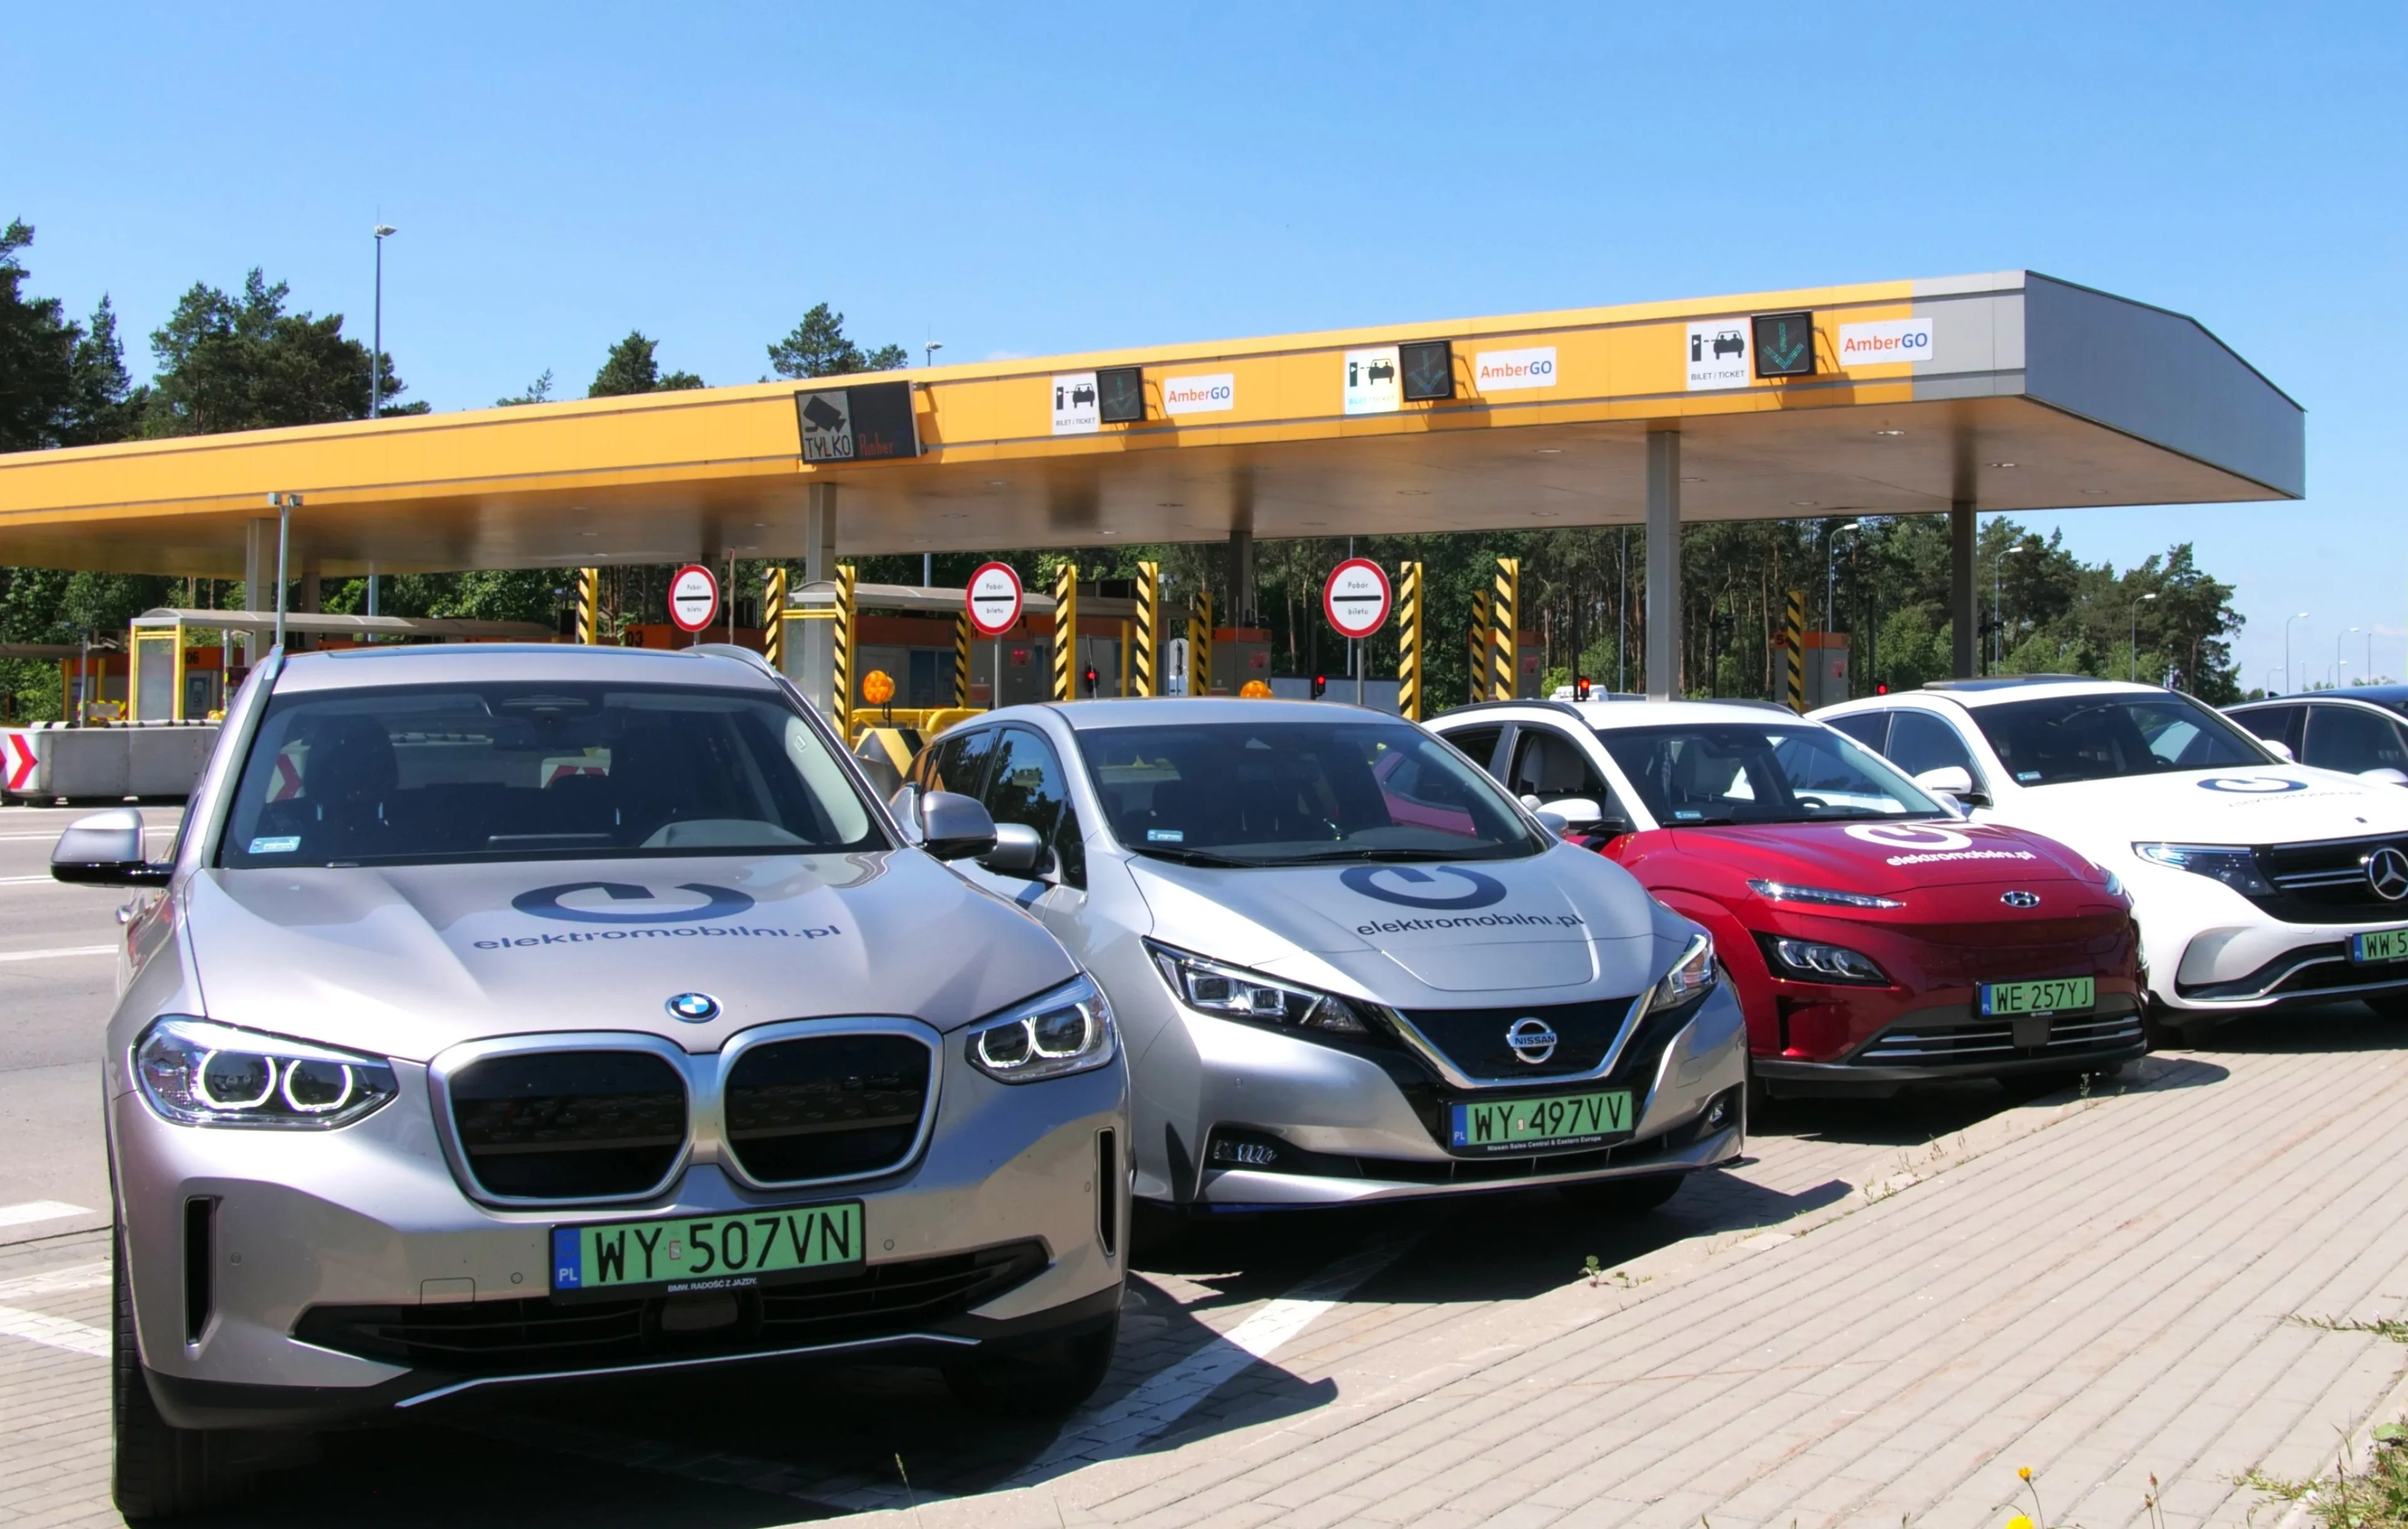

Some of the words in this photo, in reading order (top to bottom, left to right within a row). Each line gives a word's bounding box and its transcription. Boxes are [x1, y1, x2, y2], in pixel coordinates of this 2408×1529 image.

[1844, 332, 1928, 352] AmberGO
[1481, 361, 1552, 379] AmberGO
[1691, 372, 1713, 381] BILET
[1718, 370, 1745, 379] TICKET
[1168, 386, 1230, 403] AmberGO
[1055, 419, 1072, 427] BILET
[805, 434, 851, 458] TYLKO
[859, 432, 894, 456] Amber
[1887, 850, 2036, 866] elektromobilni.pl
[1357, 913, 1585, 935] elektromobilni.pl
[473, 925, 841, 949] elektromobilni.pl
[2366, 934, 2389, 958] WW
[1996, 986, 2022, 1011] WE
[2031, 981, 2088, 1009] 257YJ
[1515, 1035, 1555, 1045] NISSAN
[1475, 1105, 1514, 1142] WY
[1529, 1095, 1623, 1136] 497VV
[1454, 1132, 1465, 1141] PL
[595, 1227, 663, 1282] WY
[689, 1210, 849, 1274] 507VN
[558, 1268, 577, 1282] PL
[725, 1279, 731, 1287] Z
